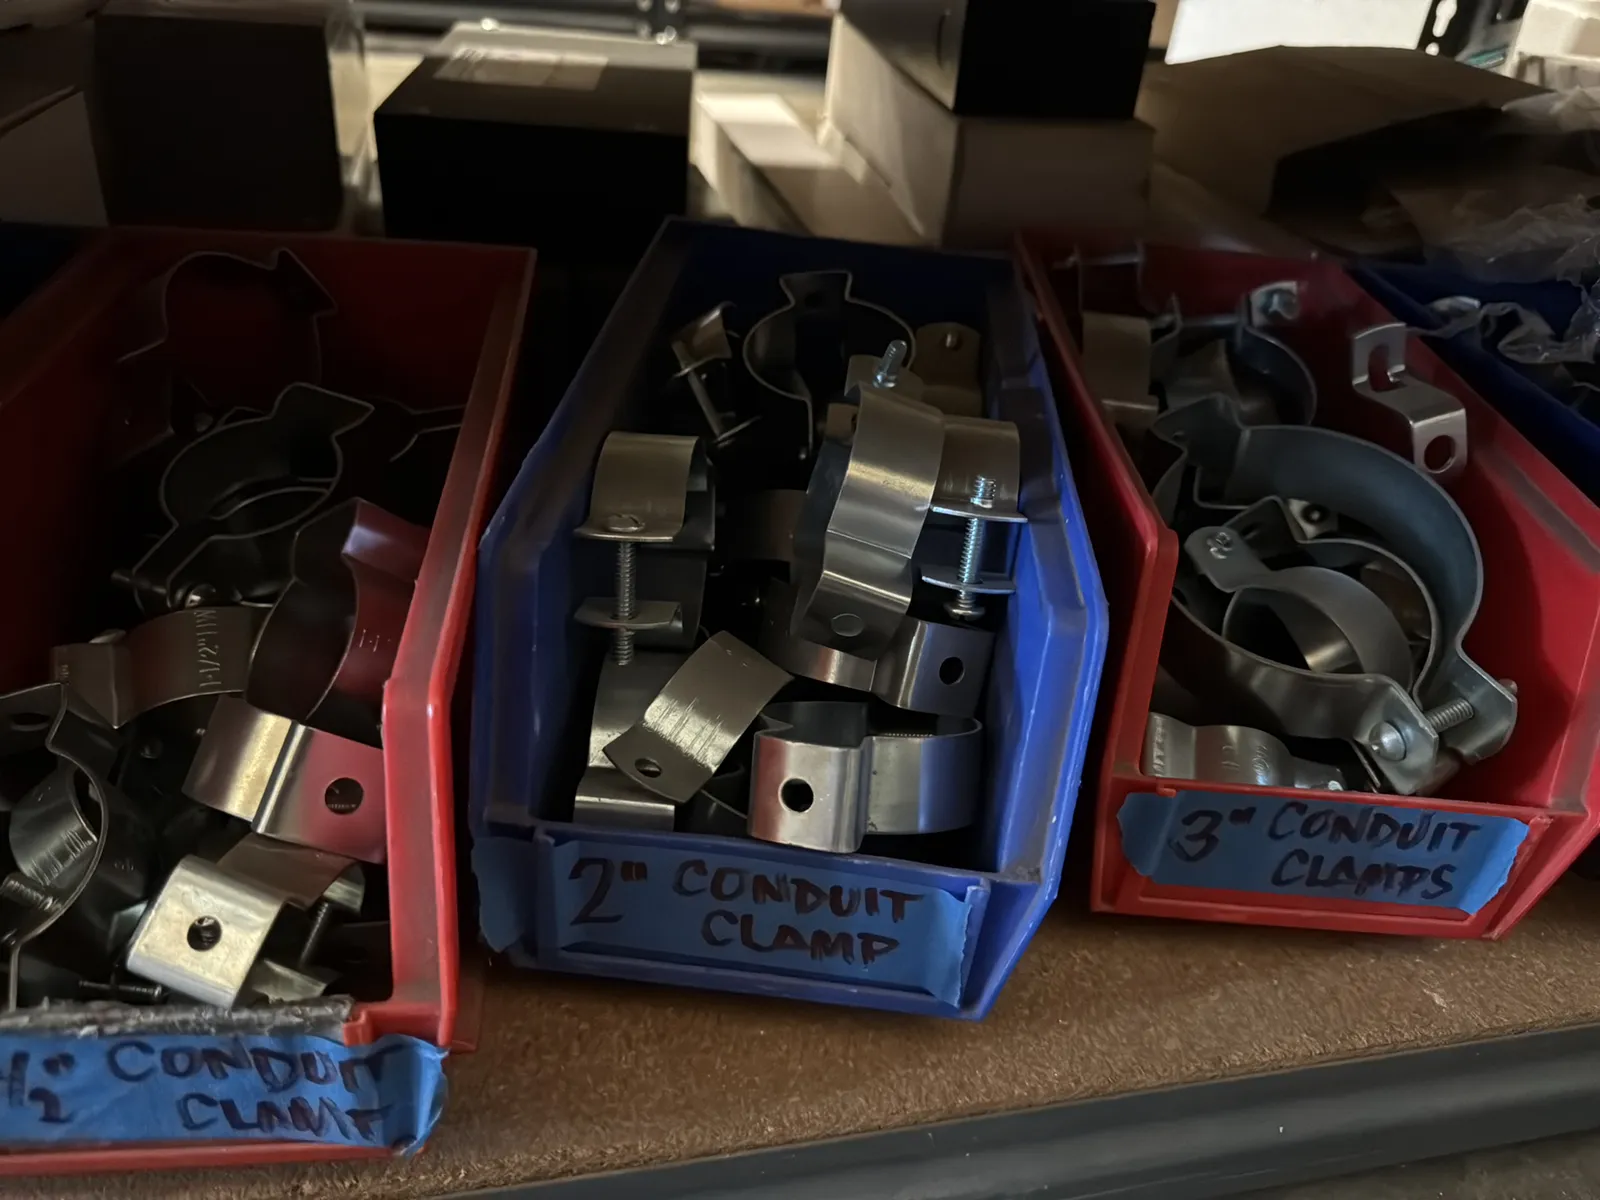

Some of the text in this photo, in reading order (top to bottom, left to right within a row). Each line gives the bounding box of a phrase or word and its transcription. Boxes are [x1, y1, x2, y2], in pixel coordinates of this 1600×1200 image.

[1167, 801, 1481, 863] 3" CONDUIT
[568, 856, 924, 926] 2" CONDUIT
[1270, 848, 1458, 900] CLAMPS
[701, 909, 899, 972] CLAMP
